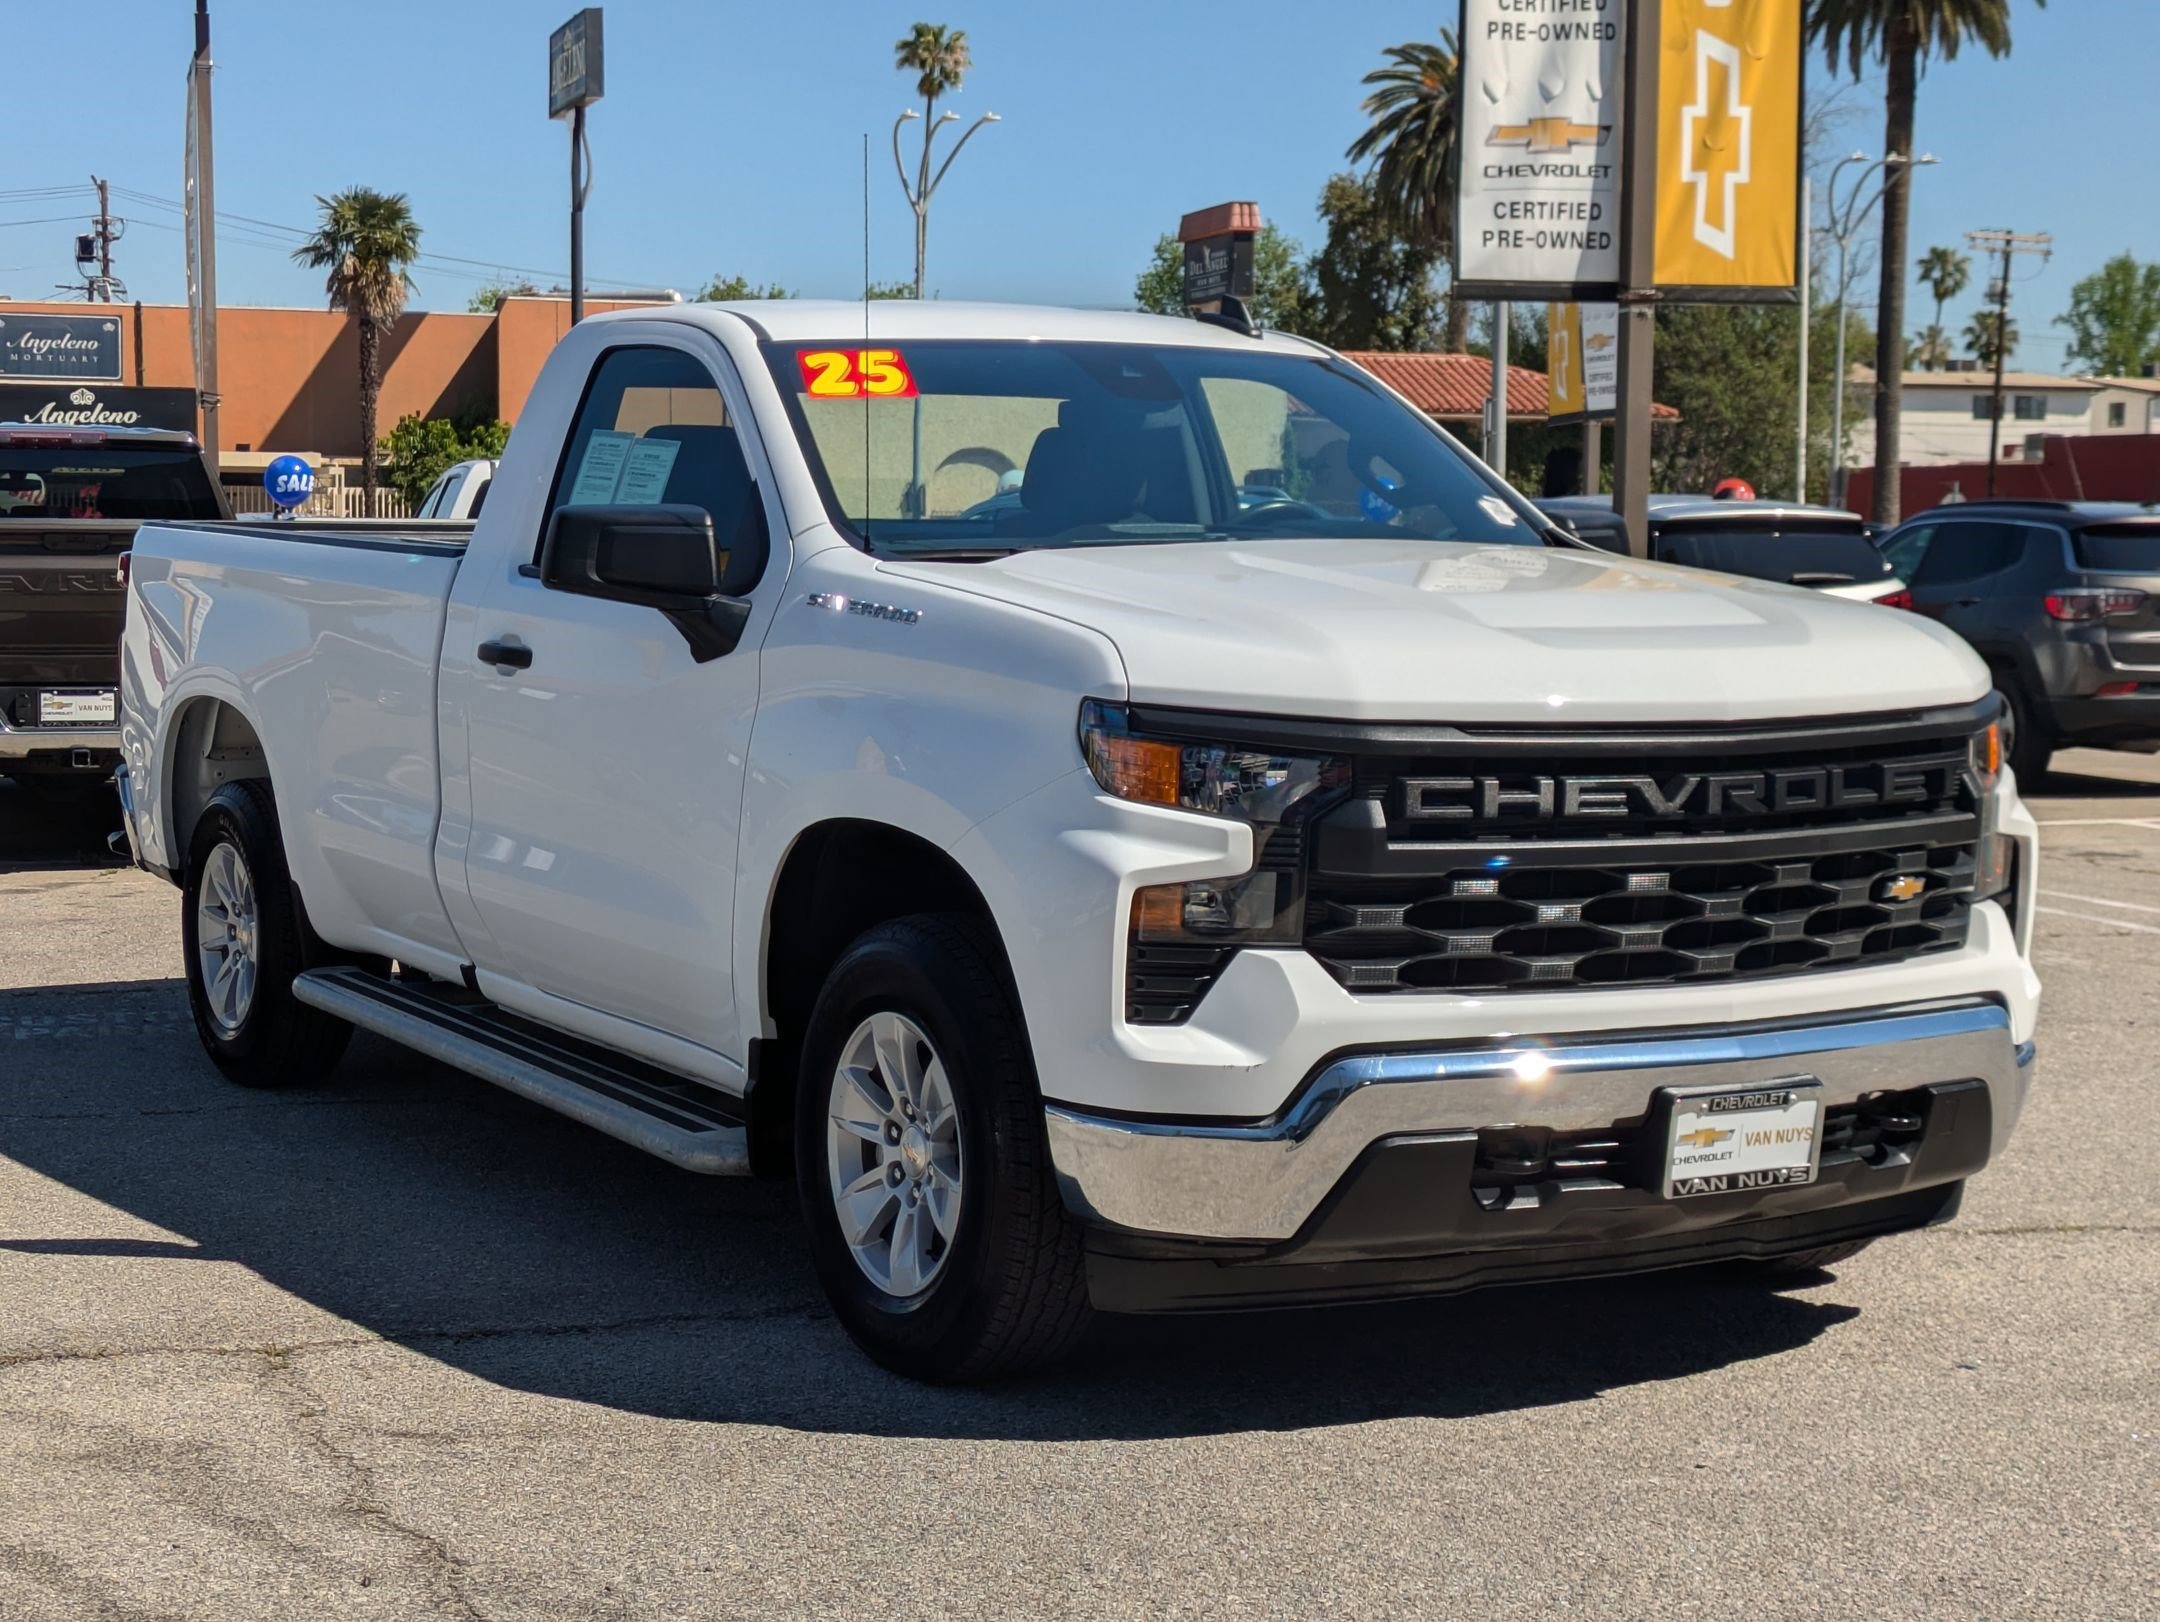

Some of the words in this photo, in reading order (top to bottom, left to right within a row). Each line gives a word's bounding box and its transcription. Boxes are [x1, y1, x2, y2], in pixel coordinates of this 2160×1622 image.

[1498, 0, 1608, 12] CERTIFIED
[1487, 21, 1616, 42] PRE-OWNED
[1483, 164, 1612, 179] CHEVROLET
[1493, 201, 1603, 222] CERTIFIED
[1482, 230, 1612, 251] PRE-OWNED
[6, 331, 99, 354] Angeleno
[10, 353, 99, 363] MORTUARY
[804, 351, 908, 396] 25
[24, 401, 141, 425] Angeleno
[1399, 757, 1968, 821] CHEVROLET
[1711, 1092, 1787, 1111] CHEVROLET
[1745, 1131, 1772, 1147] VAN
[1775, 1127, 1814, 1144] NUYS
[1673, 1151, 1733, 1165] CHEVROLET
[1675, 1175, 1728, 1195] VAN
[1738, 1167, 1808, 1189] NUYS
